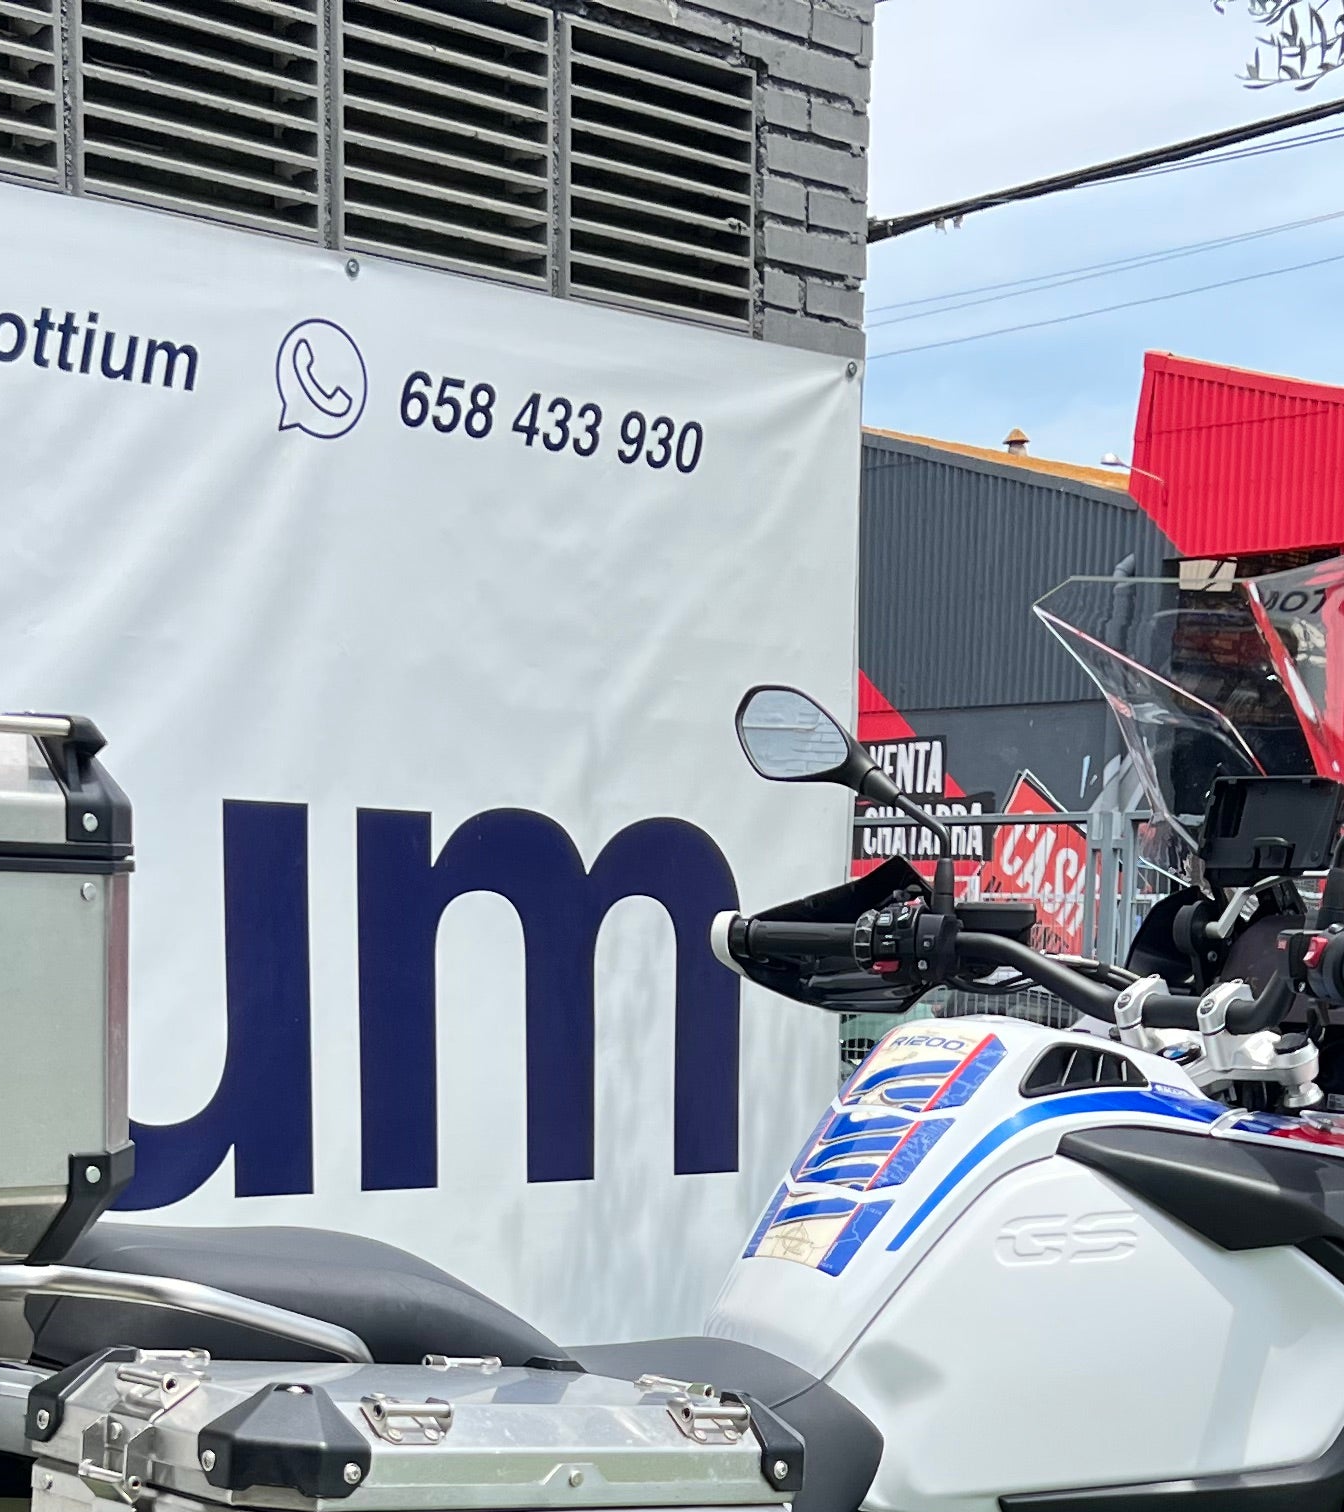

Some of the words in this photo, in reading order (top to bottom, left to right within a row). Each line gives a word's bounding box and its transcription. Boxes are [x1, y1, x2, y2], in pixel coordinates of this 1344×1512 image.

[398, 369, 494, 440] 658
[511, 391, 601, 459] 433
[617, 407, 705, 475] 930
[869, 740, 943, 794] VENTA
[995, 1210, 1138, 1267] GS
